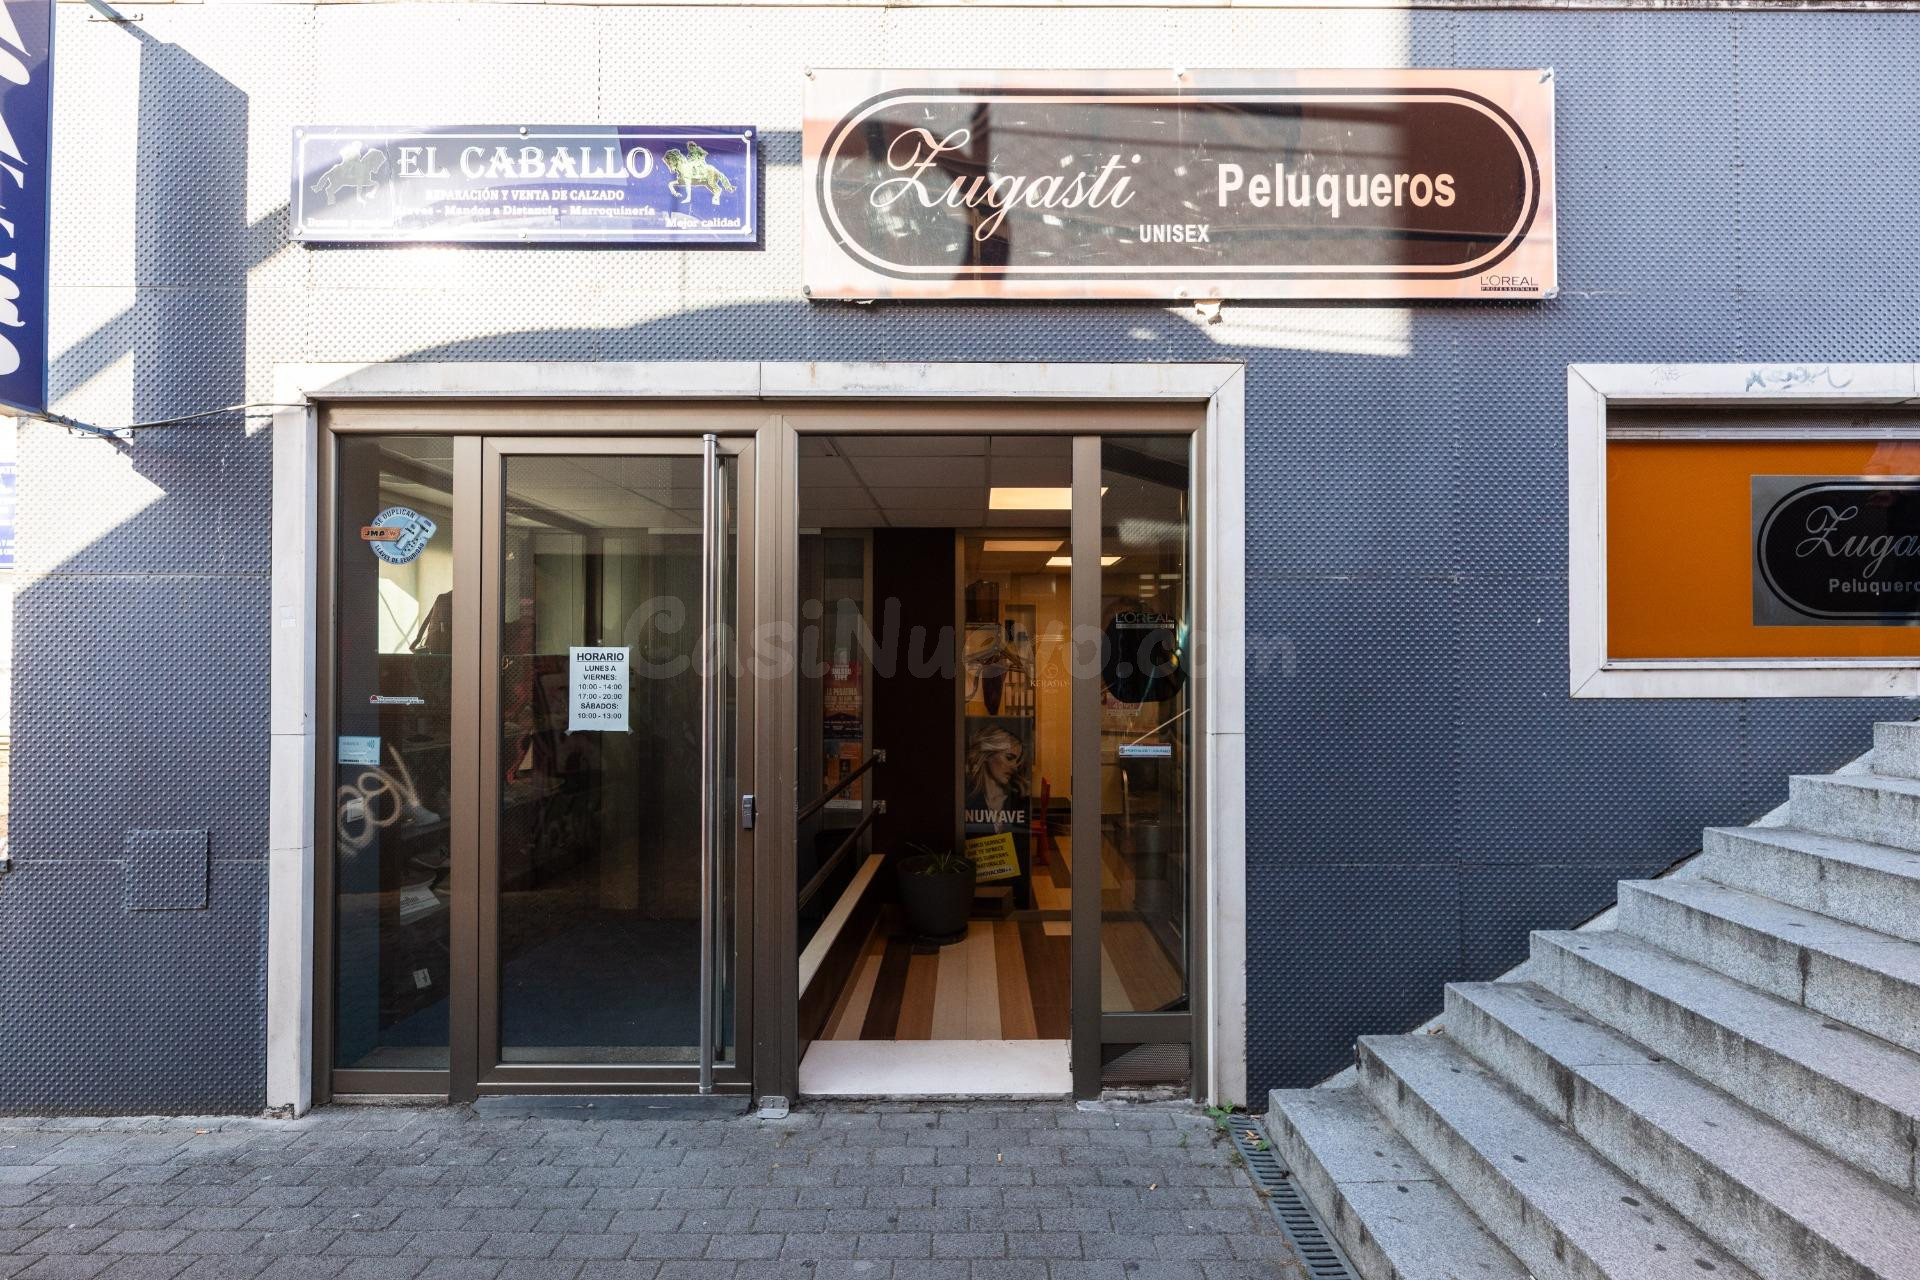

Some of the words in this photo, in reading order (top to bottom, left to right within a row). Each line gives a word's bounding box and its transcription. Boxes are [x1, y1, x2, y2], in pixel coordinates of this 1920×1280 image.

[397, 146, 450, 178] EL
[460, 146, 654, 178] CABALLO
[869, 127, 1141, 242] Zugasti
[1217, 162, 1456, 219] Peluqueros
[500, 189, 509, 201] Y
[512, 189, 549, 201] VENTA
[552, 189, 568, 201] DE
[570, 189, 625, 201] CALZADO
[444, 205, 490, 217] Mandos
[502, 205, 559, 216] Distancia
[570, 205, 655, 218] Marroquinería
[665, 217, 698, 229] Mejor
[701, 217, 741, 227] calidad
[1139, 224, 1210, 244] UNISEX
[382, 508, 416, 519] DUPLICAN
[1796, 505, 1920, 579] Zuga
[576, 653, 624, 661] HORARIO
[964, 809, 1025, 823] NUWAVE
